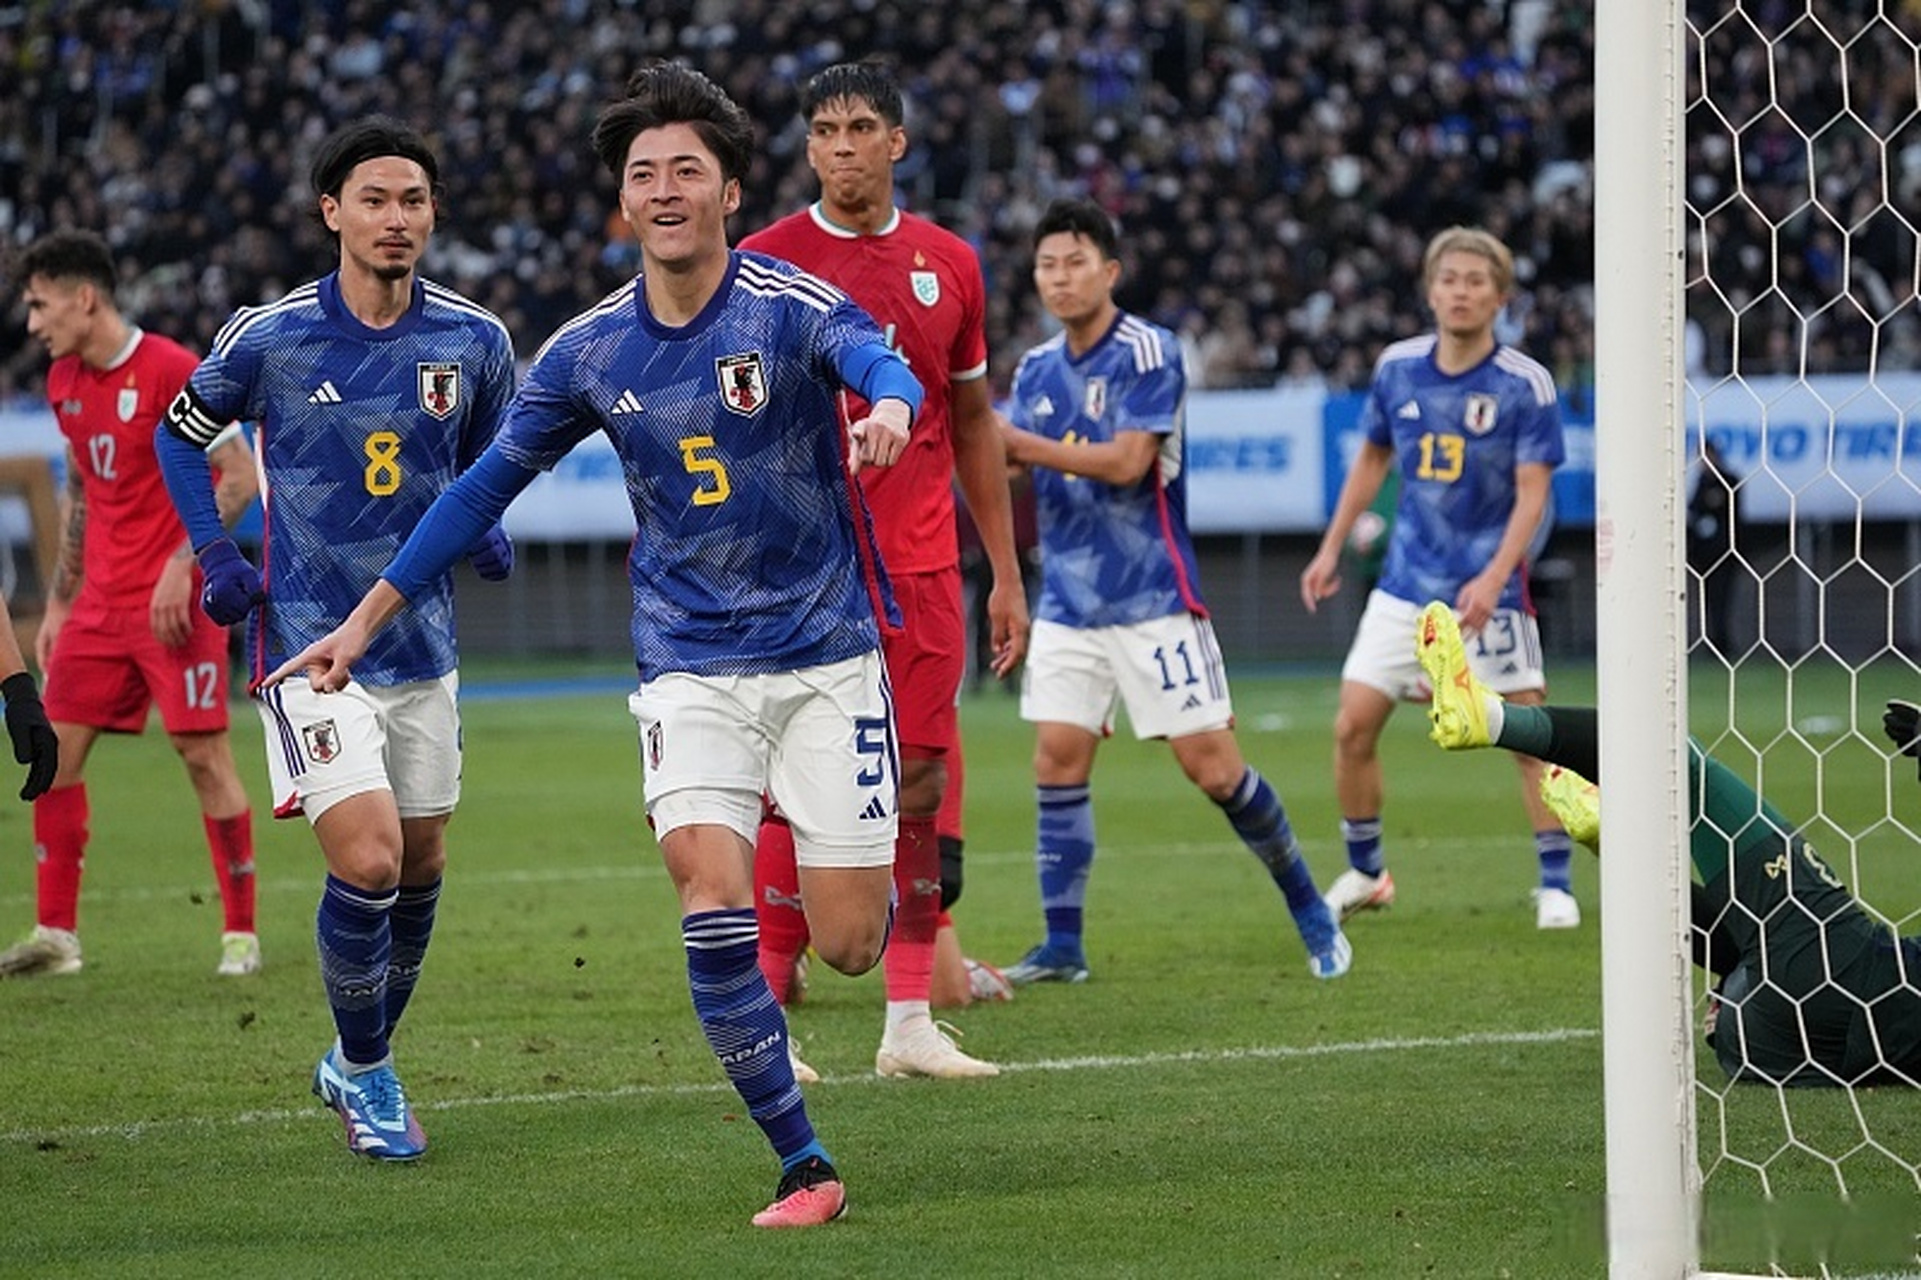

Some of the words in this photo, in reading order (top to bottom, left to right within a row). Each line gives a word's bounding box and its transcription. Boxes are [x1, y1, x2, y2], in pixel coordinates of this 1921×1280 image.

[169, 390, 191, 423] C
[88, 433, 118, 480] 12
[364, 431, 401, 496] 8
[679, 435, 732, 506] 5
[1417, 432, 1466, 482] 13
[184, 661, 218, 710] 12
[1153, 640, 1200, 691] 11
[855, 718, 885, 786] 5
